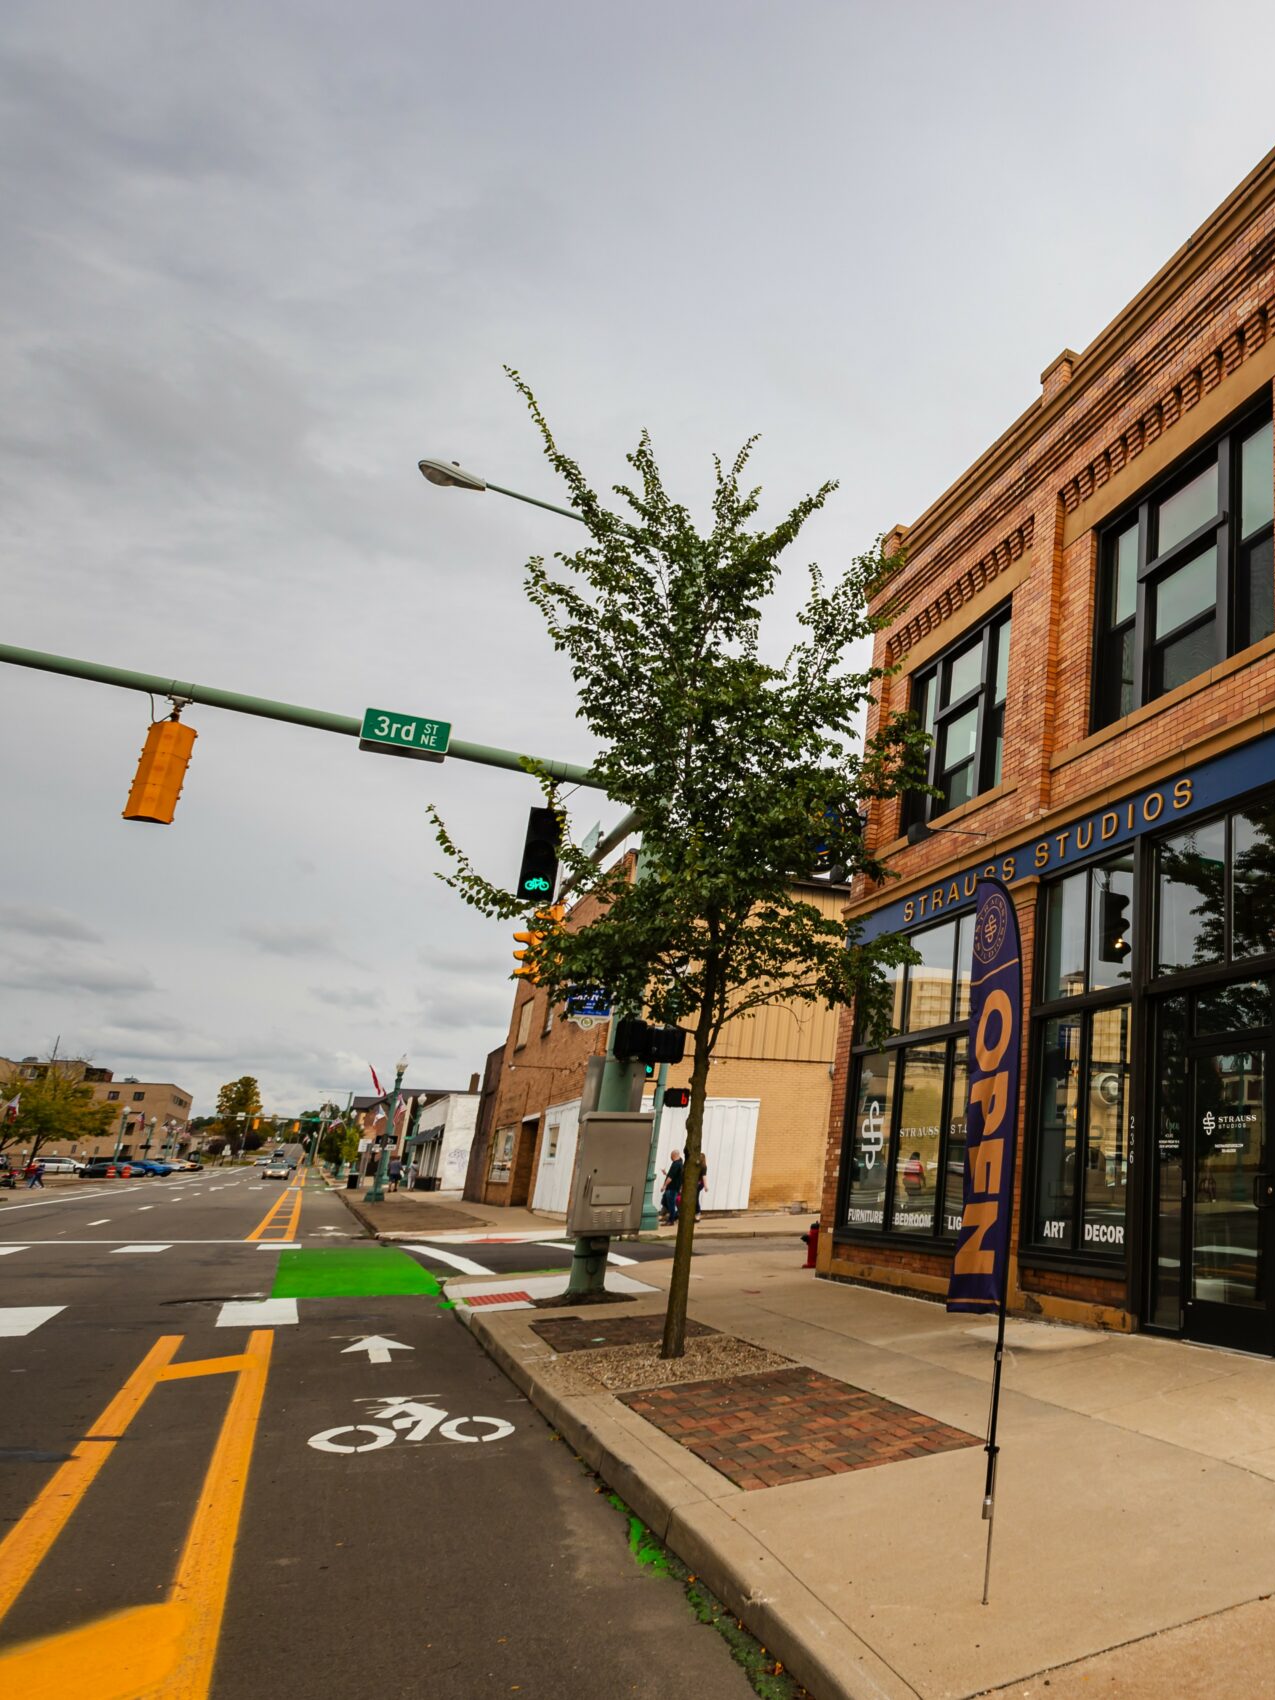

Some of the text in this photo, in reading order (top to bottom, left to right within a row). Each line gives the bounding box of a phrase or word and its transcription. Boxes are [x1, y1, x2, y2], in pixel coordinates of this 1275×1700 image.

[374, 716, 439, 742] 3rd ST
[420, 734, 437, 747] NE
[1034, 778, 1193, 868] STUDIOS
[1218, 1115, 1257, 1123] STRAUSS
[900, 1126, 940, 1137] STRAUSS
[954, 989, 1013, 1275] OPEN
[848, 1208, 884, 1224] FURNITURE
[894, 1213, 931, 1227] BEDROOM
[1043, 1220, 1124, 1244] ART DECOR
